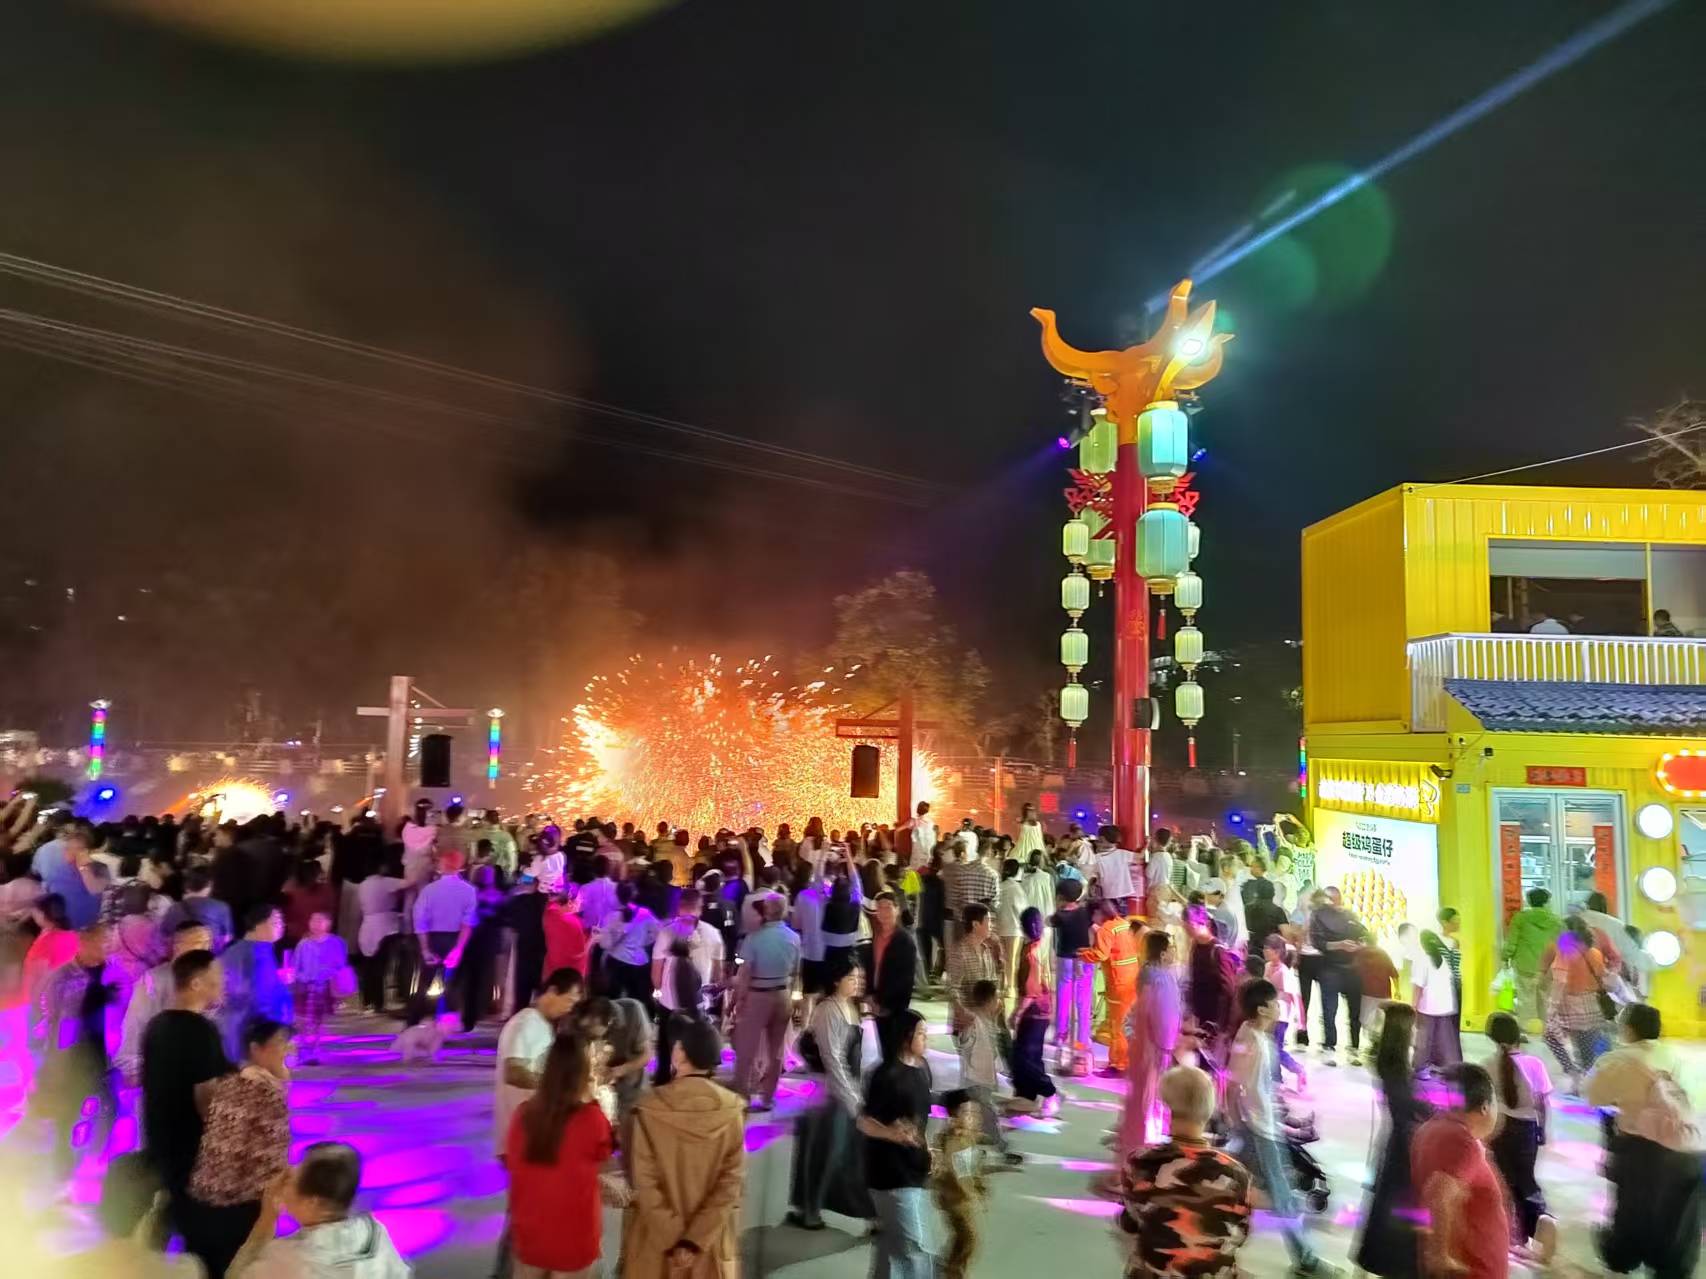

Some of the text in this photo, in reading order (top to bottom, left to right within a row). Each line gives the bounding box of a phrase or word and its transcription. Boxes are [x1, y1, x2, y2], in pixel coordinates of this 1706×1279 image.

[1342, 831, 1393, 857] 超级鸡蛋仔
